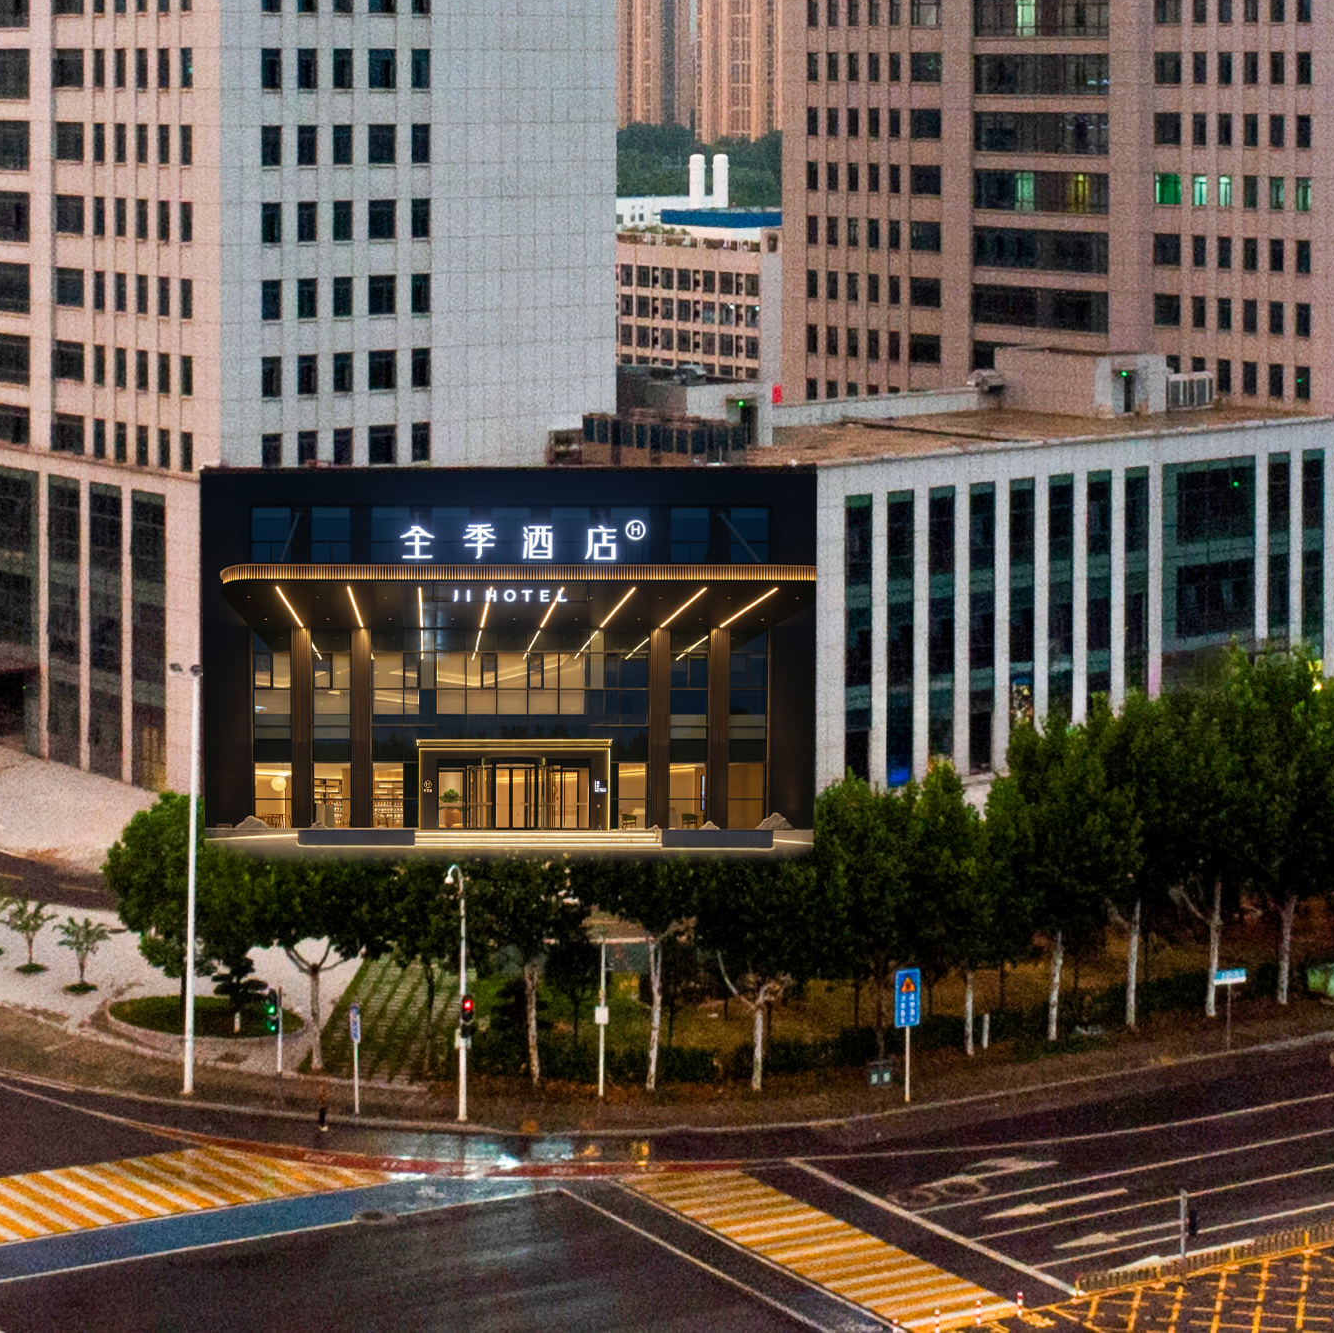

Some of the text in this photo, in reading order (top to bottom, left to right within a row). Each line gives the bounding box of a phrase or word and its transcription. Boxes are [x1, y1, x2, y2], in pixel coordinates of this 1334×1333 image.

[399, 523, 617, 561] 全季酒店
[453, 589, 568, 603] JI HOTEL
